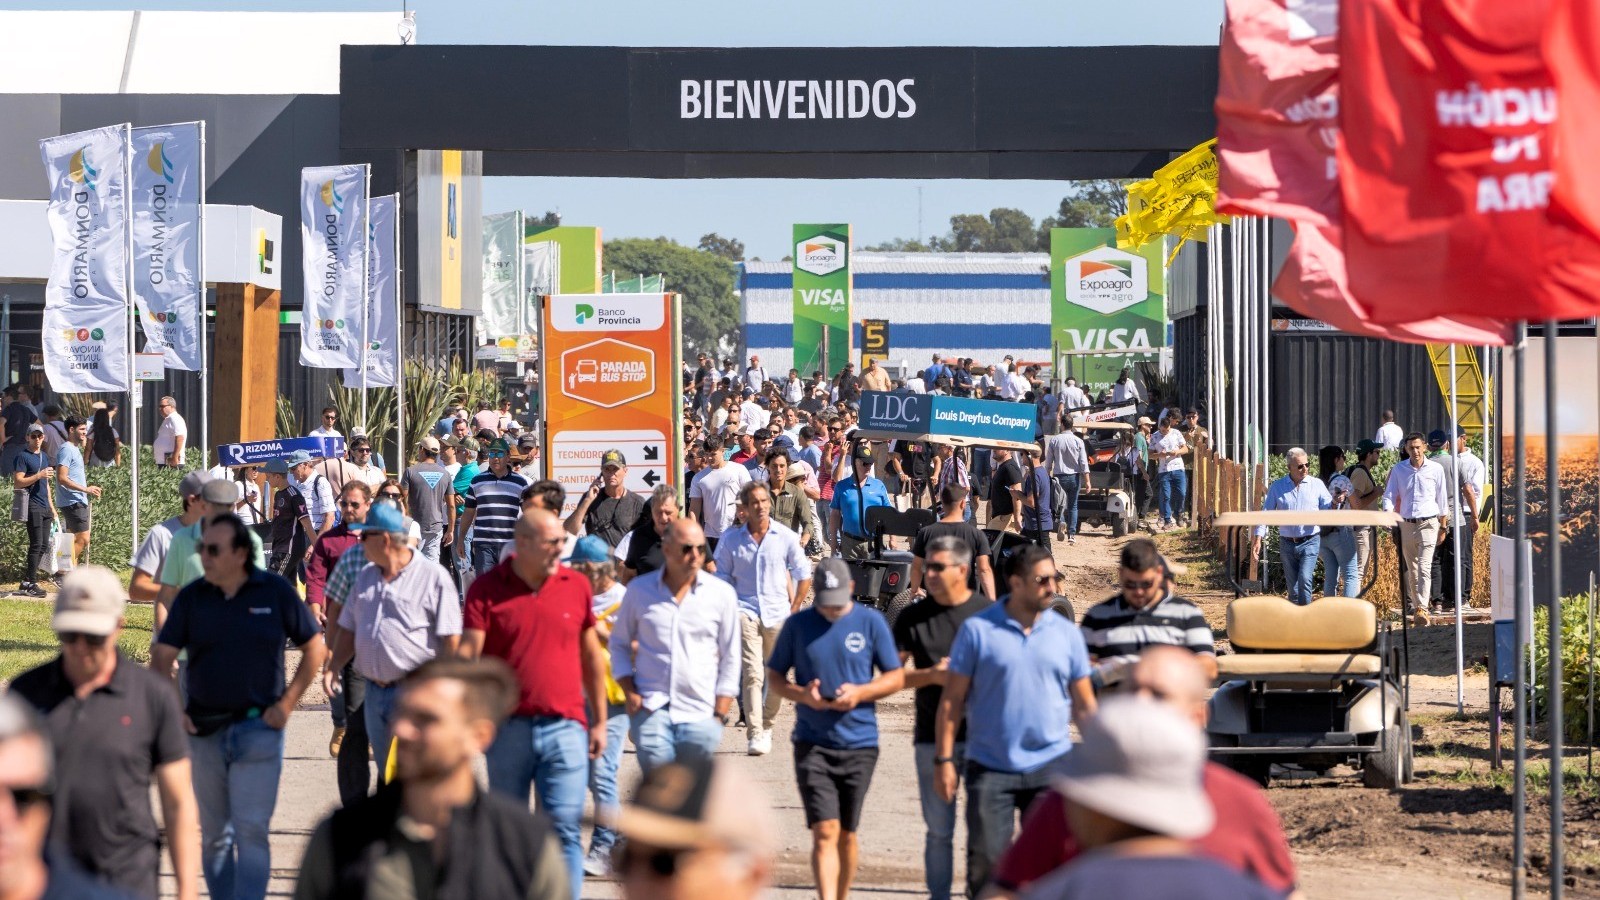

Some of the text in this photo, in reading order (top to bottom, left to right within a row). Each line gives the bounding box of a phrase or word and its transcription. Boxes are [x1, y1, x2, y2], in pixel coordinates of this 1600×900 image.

[680, 78, 917, 119] BIENVENIDOS
[805, 254, 837, 262] Expoagro
[1080, 279, 1133, 292] Expoagro
[797, 288, 845, 305] VISA
[1111, 293, 1133, 302] agro
[598, 308, 626, 316] Banco
[598, 317, 641, 325] Provincia
[866, 325, 884, 348] 5
[1063, 328, 1153, 358] VISA
[600, 361, 647, 373] PARADA
[601, 372, 647, 382] BUS STOP
[870, 394, 920, 423] LDC.
[935, 408, 1031, 430] Louis Dreyfus Company
[1095, 411, 1117, 421] AKRON
[245, 442, 283, 453] RIZOMA
[558, 475, 597, 484] SANITAR
